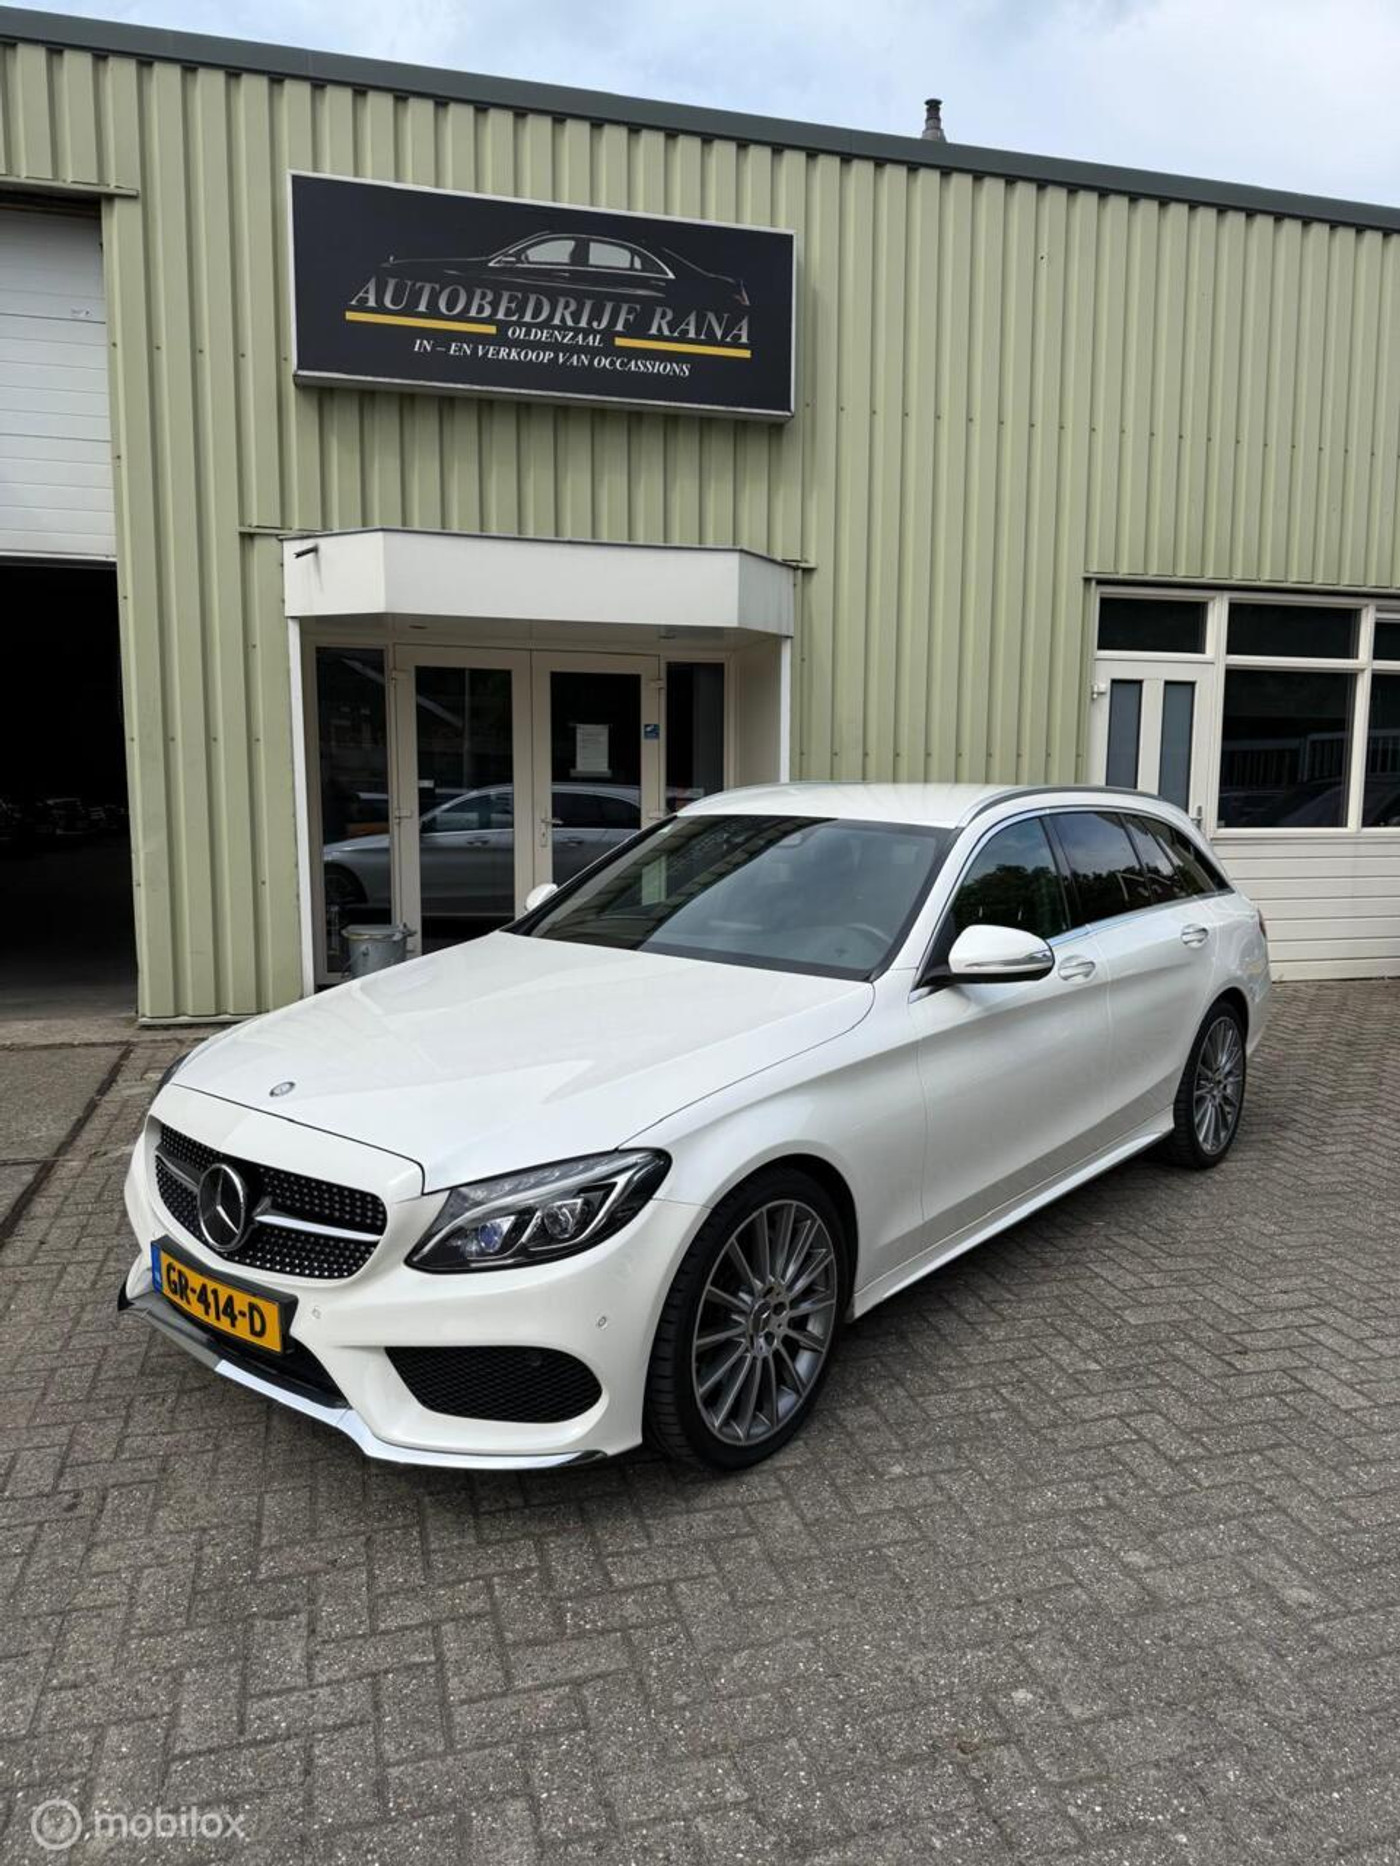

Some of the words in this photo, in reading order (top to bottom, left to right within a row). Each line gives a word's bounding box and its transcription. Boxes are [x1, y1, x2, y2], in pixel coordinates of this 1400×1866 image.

[350, 275, 641, 332] AUTOBEDRIJF
[647, 305, 750, 343] RANA
[413, 338, 434, 352] IN
[449, 341, 474, 356] EN
[477, 345, 555, 363] VERKOOP
[558, 351, 591, 367] VAN
[594, 355, 691, 377] OCCASSIONS
[508, 325, 604, 347] OLDENZAAL
[166, 1261, 267, 1338] GR-414-D
